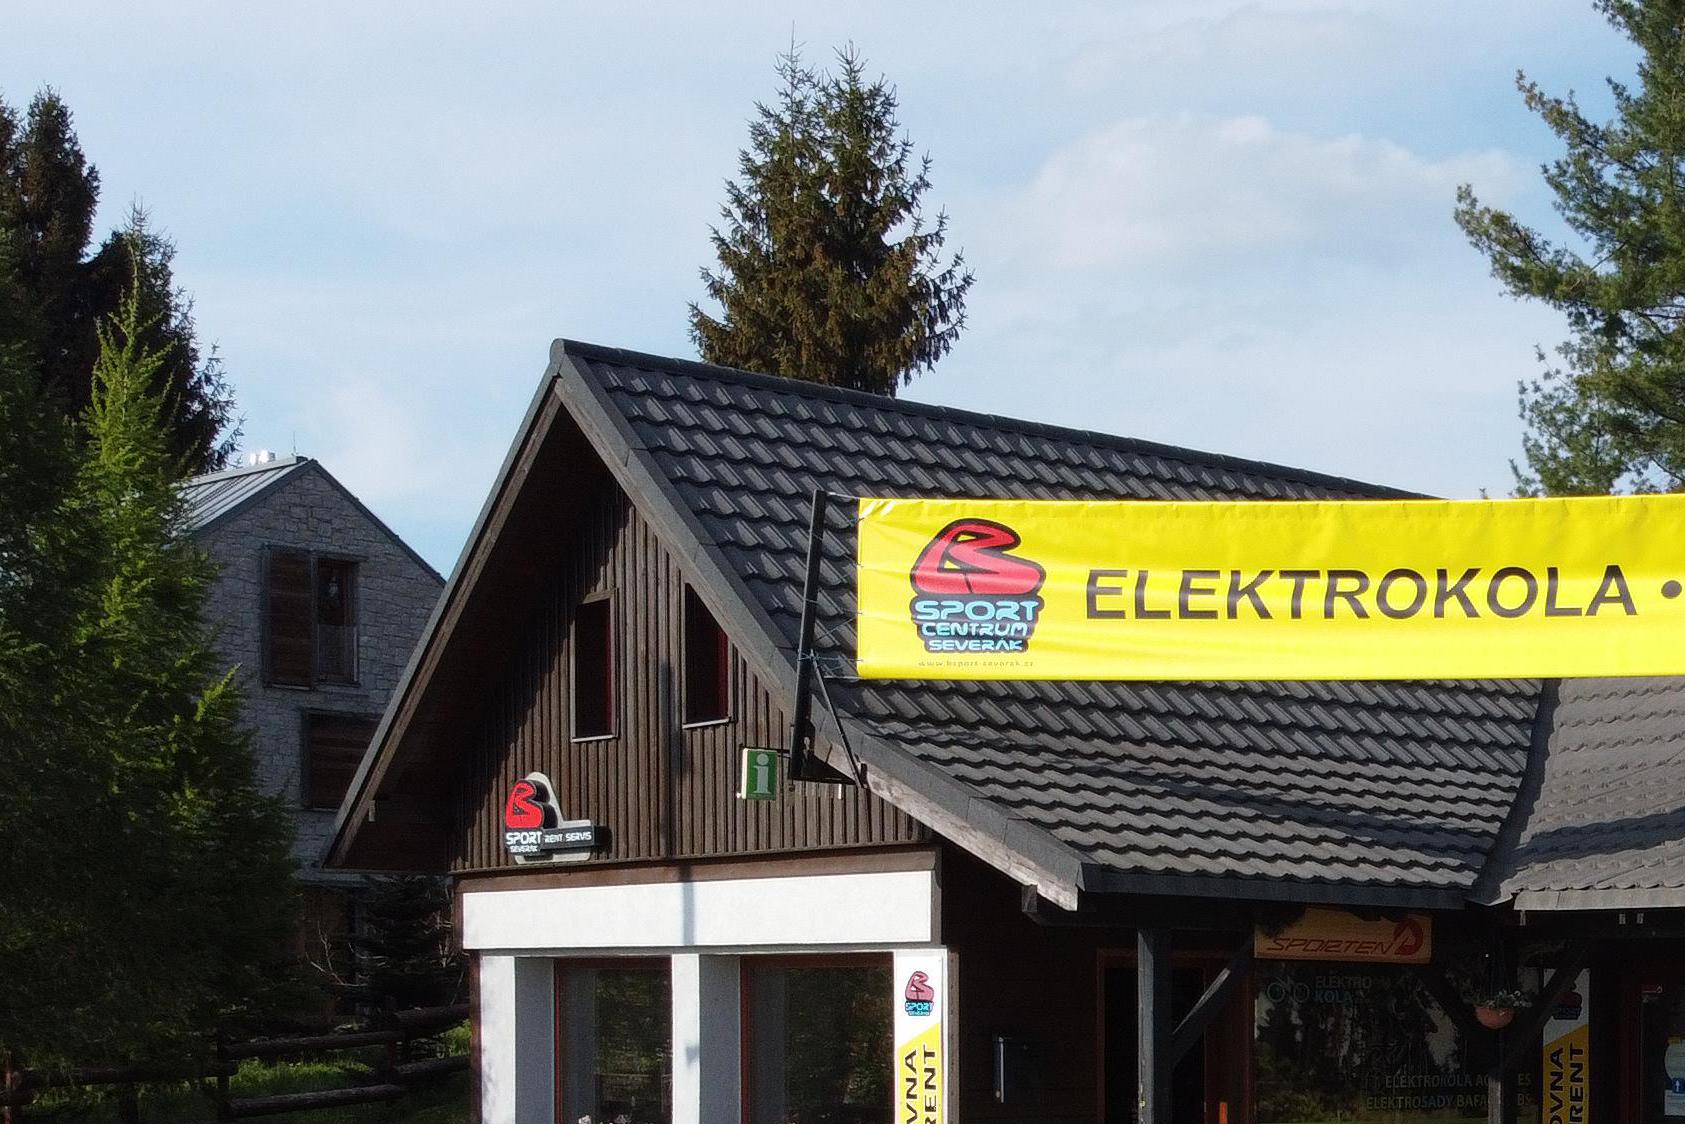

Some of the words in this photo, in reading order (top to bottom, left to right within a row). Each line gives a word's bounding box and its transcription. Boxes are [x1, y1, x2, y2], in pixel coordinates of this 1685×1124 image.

[1087, 565, 1637, 620] ELEKTROKOLA
[914, 600, 1039, 621] SPORT
[921, 622, 1028, 636] CENTRUM
[928, 637, 1023, 651] SEVERÁK
[506, 831, 542, 845] SPORT
[1570, 1043, 1583, 1122] RENT
